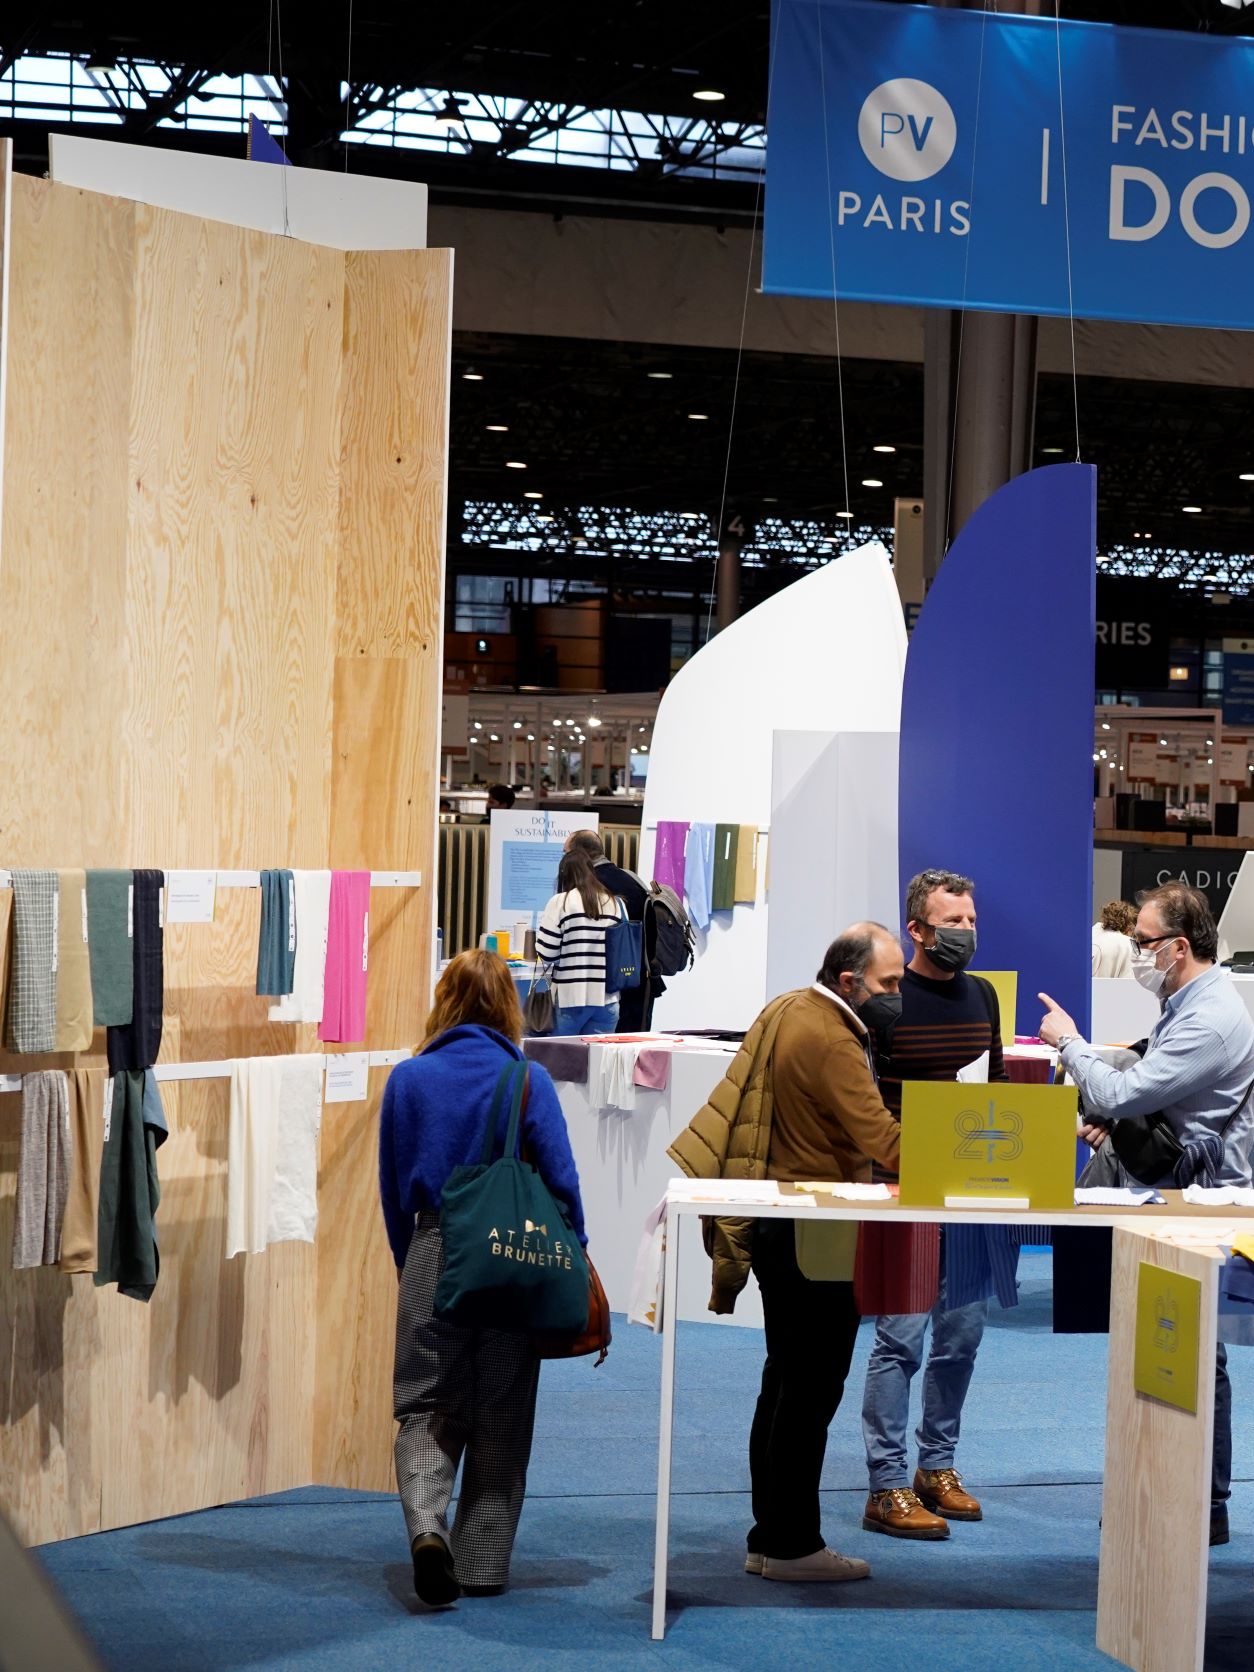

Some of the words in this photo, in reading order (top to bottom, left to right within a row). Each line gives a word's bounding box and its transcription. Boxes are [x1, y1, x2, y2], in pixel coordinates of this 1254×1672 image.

[880, 111, 935, 152] PV
[837, 190, 971, 237] PARIS
[1108, 164, 1251, 249] DO
[727, 515, 746, 537] 4
[531, 816, 546, 825] DO
[547, 821, 556, 829] IT
[491, 1242, 572, 1270] BRUNETTE
